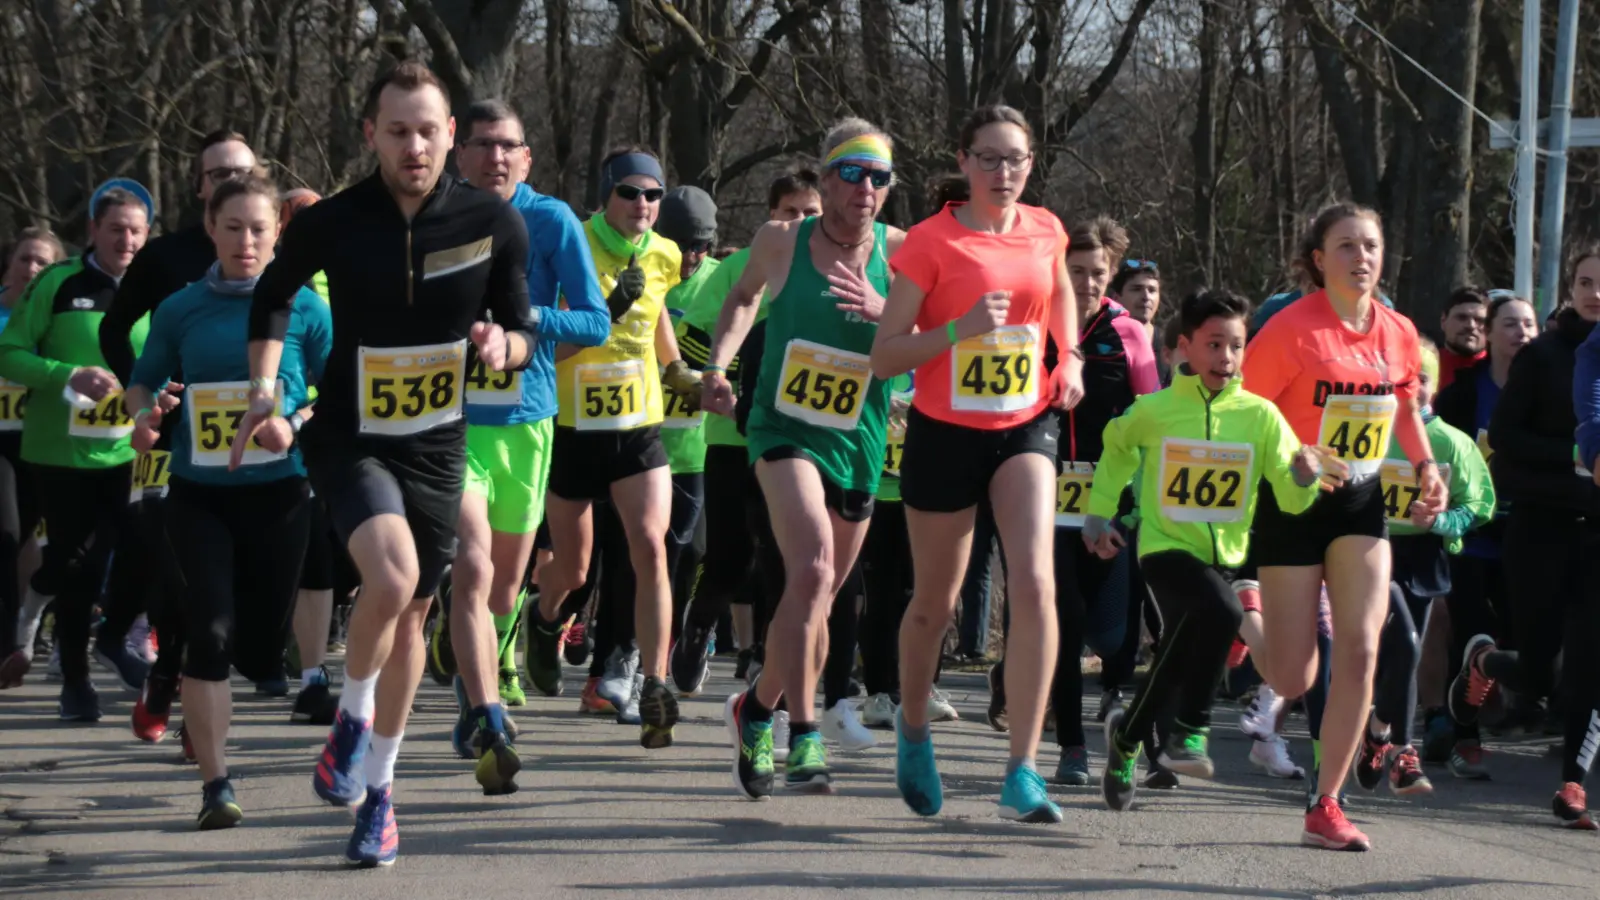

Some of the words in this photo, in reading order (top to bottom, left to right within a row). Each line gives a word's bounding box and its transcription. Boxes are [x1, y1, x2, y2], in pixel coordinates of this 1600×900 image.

[370, 371, 454, 418] 538
[784, 368, 860, 416] 458
[961, 353, 1031, 396] 439
[585, 384, 634, 418] 531
[200, 410, 264, 450] 53
[1328, 421, 1382, 459] 461
[1166, 467, 1241, 508] 462
